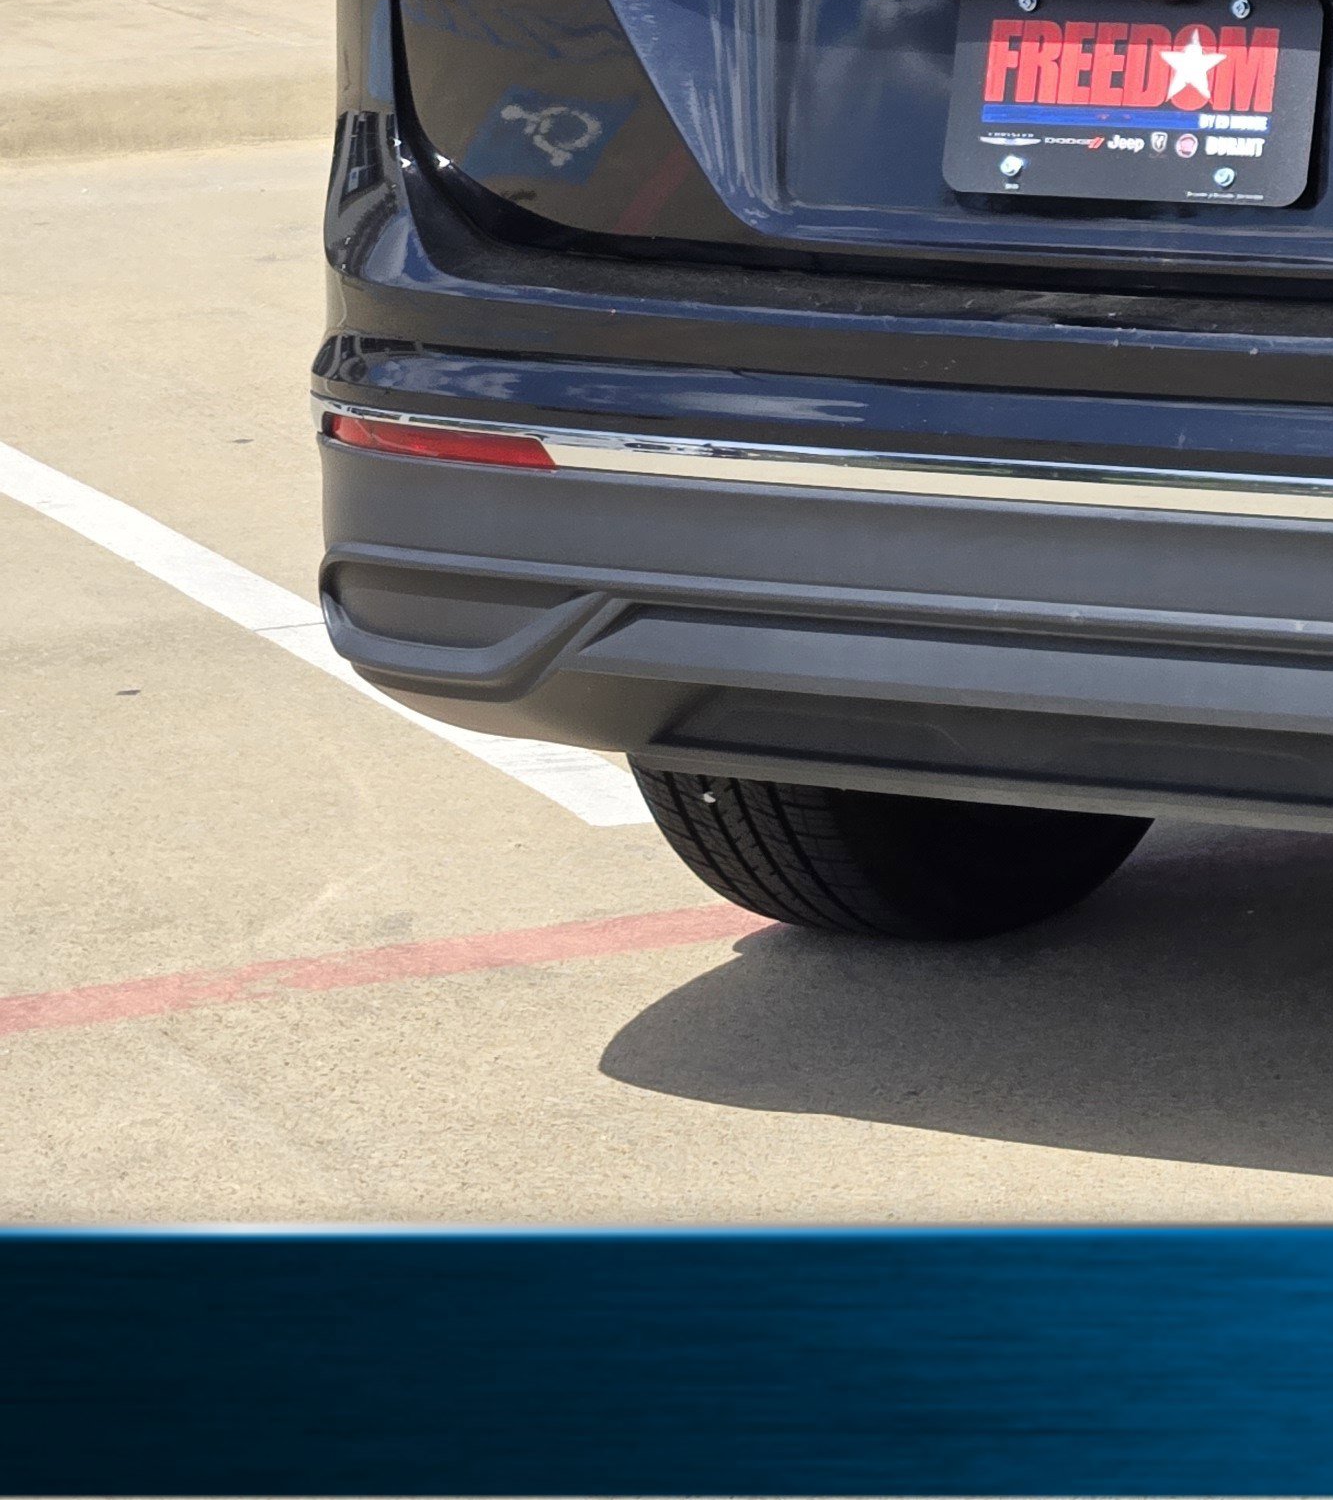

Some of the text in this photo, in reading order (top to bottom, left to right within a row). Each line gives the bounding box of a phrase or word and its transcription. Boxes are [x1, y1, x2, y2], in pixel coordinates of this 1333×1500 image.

[983, 18, 1281, 113] FREEDOM
[1107, 134, 1145, 153] Jeep
[1205, 135, 1266, 158] DURANT
